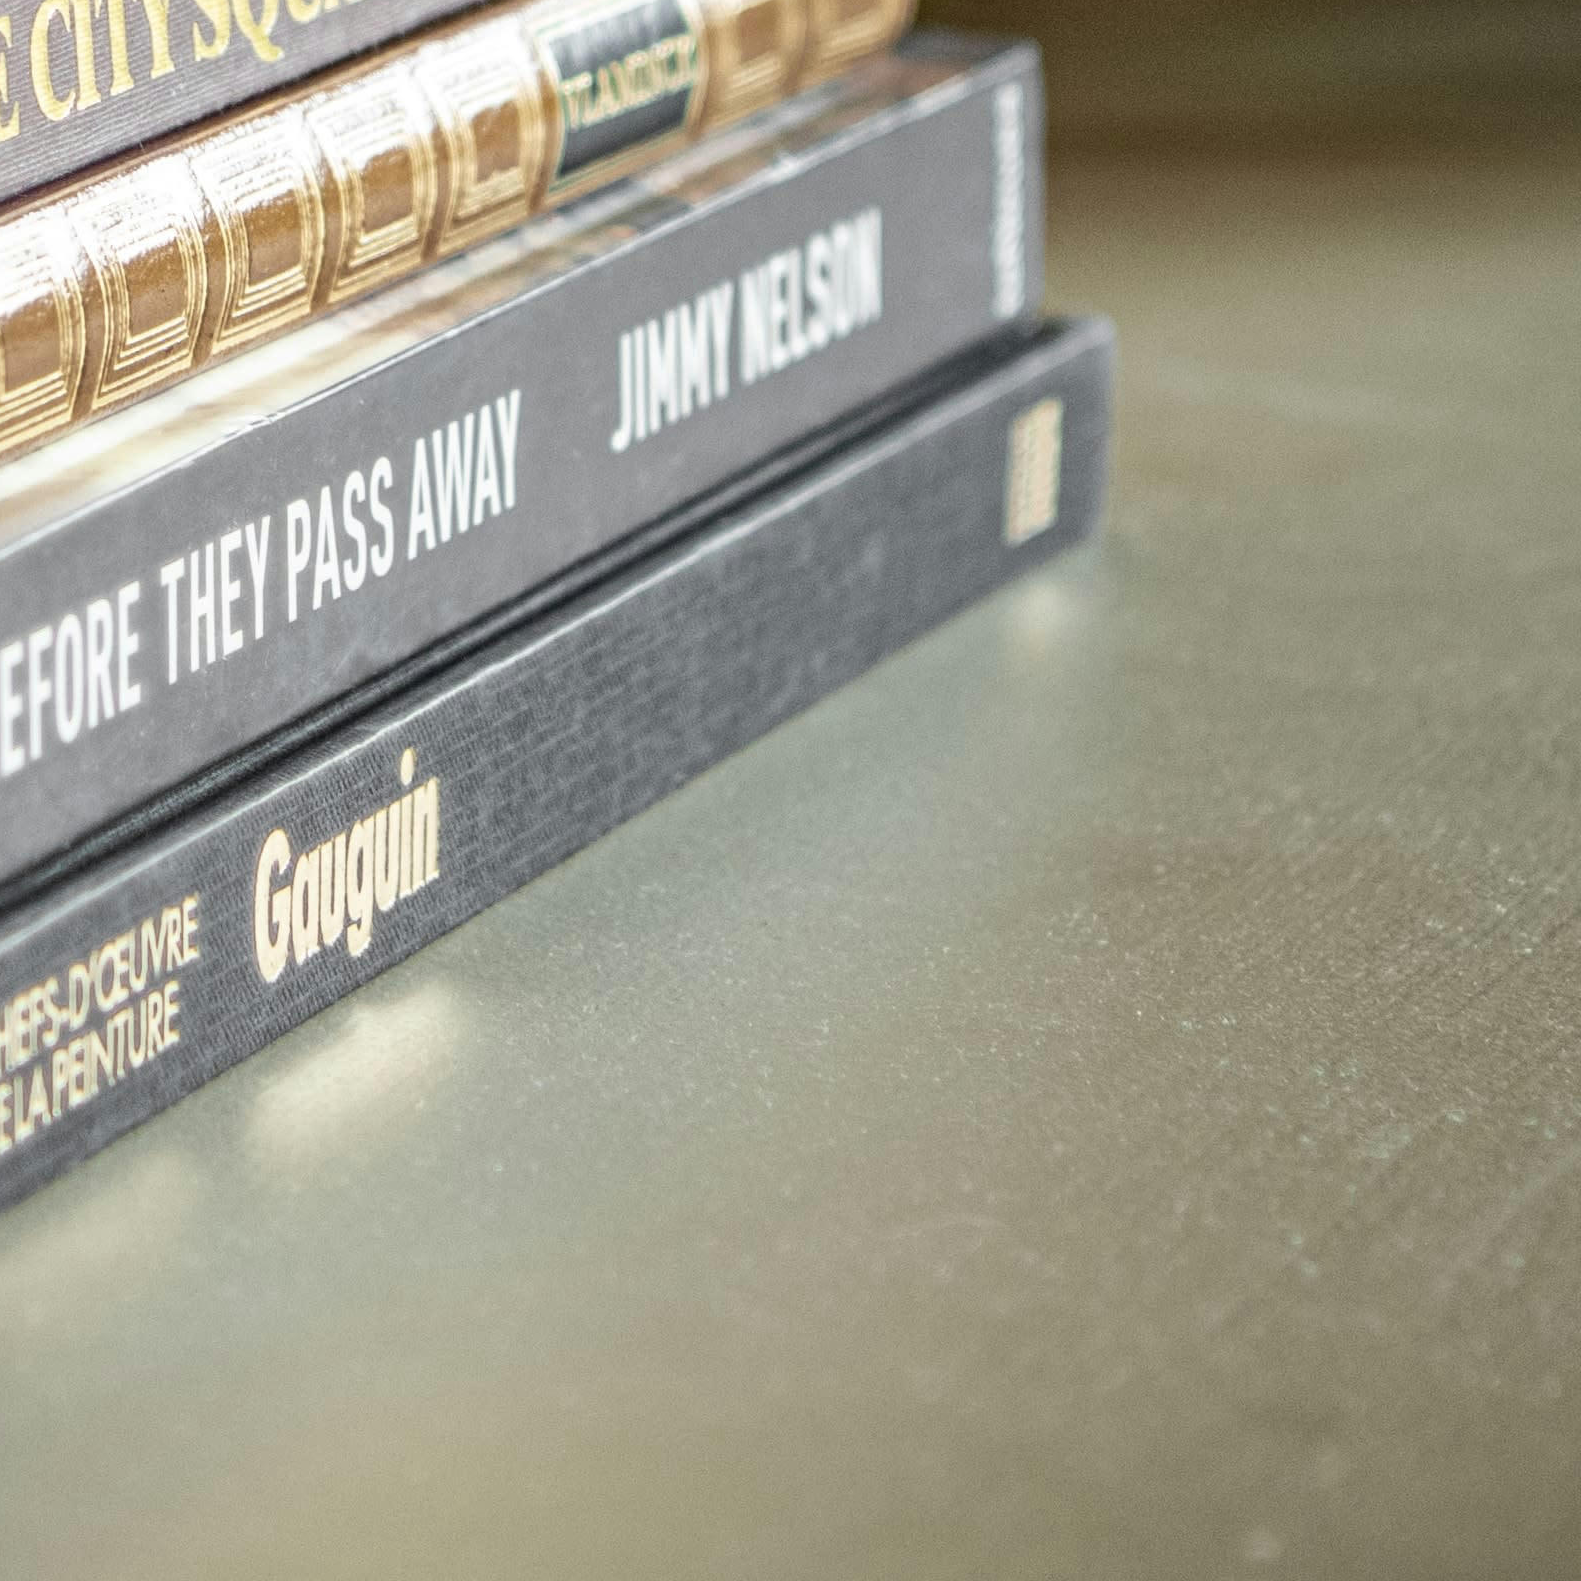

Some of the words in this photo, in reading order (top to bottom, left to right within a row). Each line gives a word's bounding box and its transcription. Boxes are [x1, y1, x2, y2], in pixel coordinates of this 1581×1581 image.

[609, 284, 734, 453] JIMMY
[739, 205, 884, 386] NELSON
[158, 514, 271, 686] THEY
[286, 455, 395, 623] PASS
[405, 390, 523, 563] AWAY
[253, 748, 441, 984] Gauguin
[14, 1057, 53, 1141] LA
[50, 978, 181, 1126] PEINTURE
